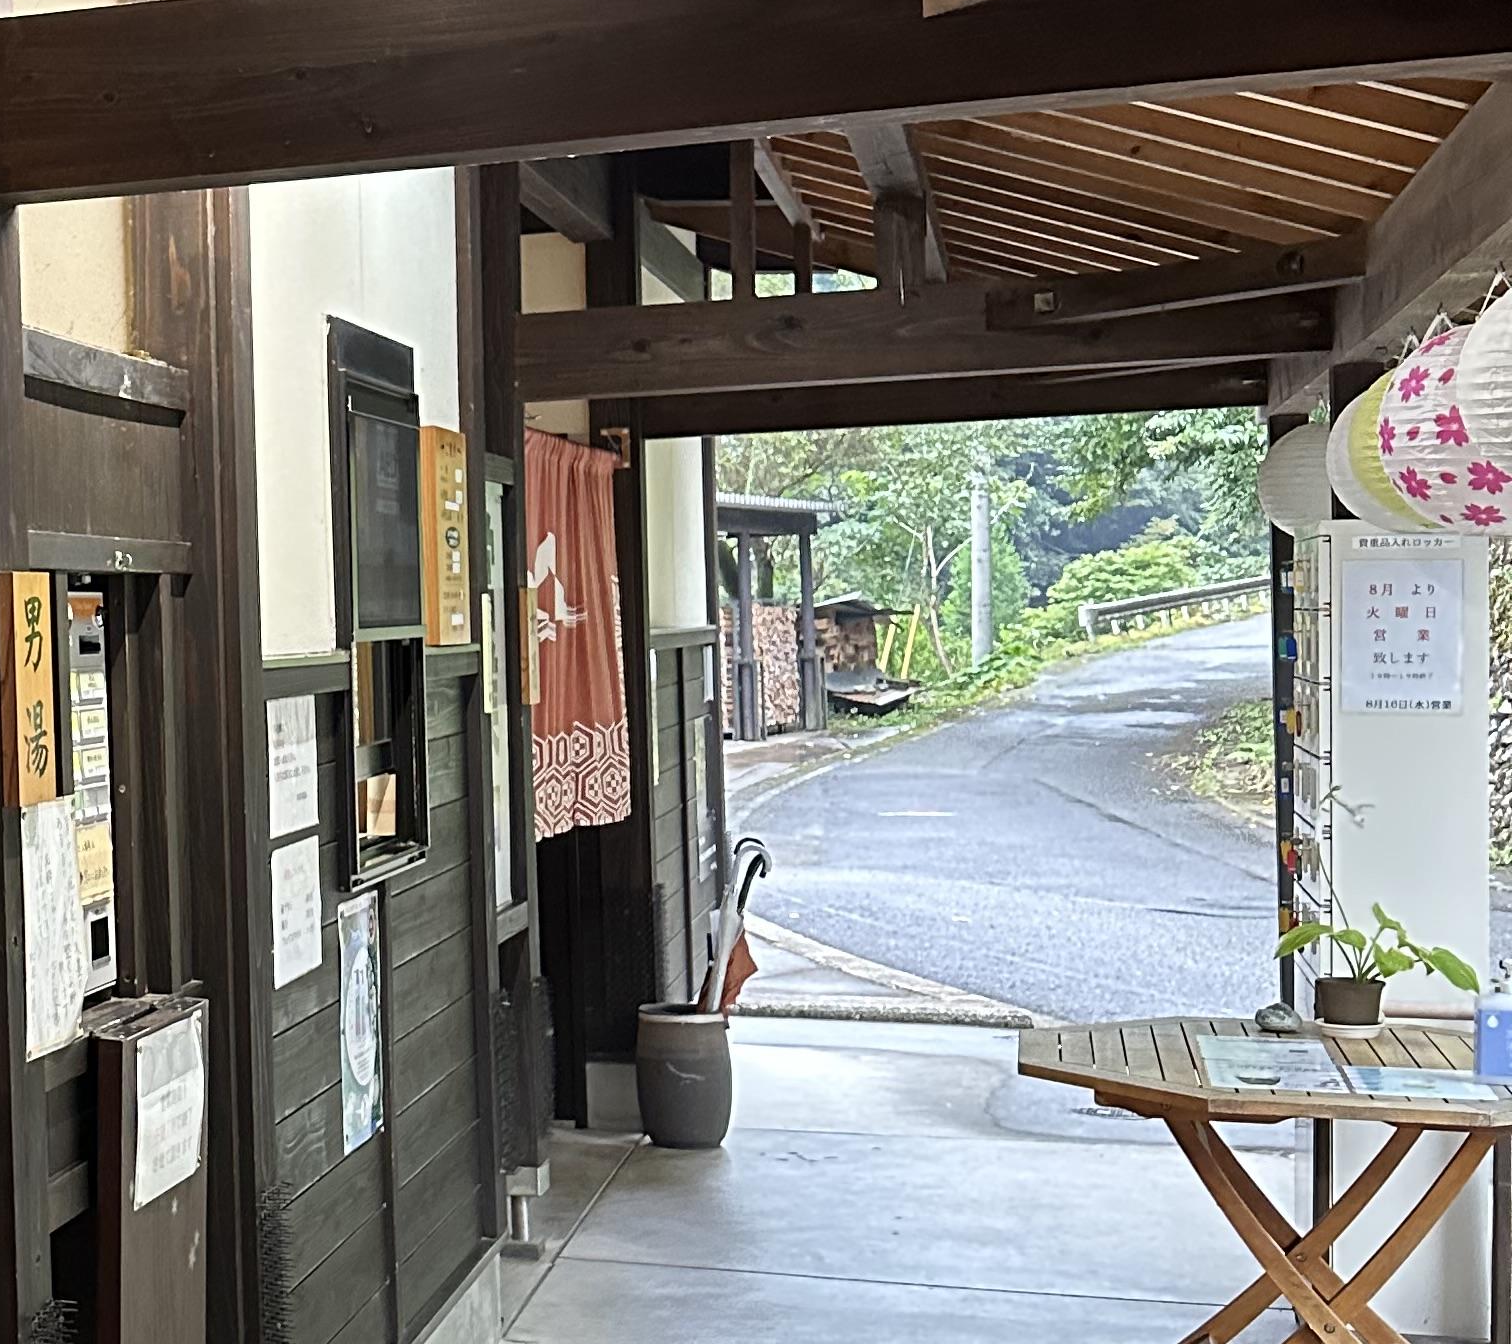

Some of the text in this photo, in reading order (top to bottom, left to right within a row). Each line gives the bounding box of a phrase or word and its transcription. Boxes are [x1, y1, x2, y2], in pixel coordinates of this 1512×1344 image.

[1358, 537, 1455, 548] 貴重品入れロッカー
[1410, 583, 1436, 596] より
[1372, 651, 1431, 665] 致します
[23, 593, 50, 779] 男湯
